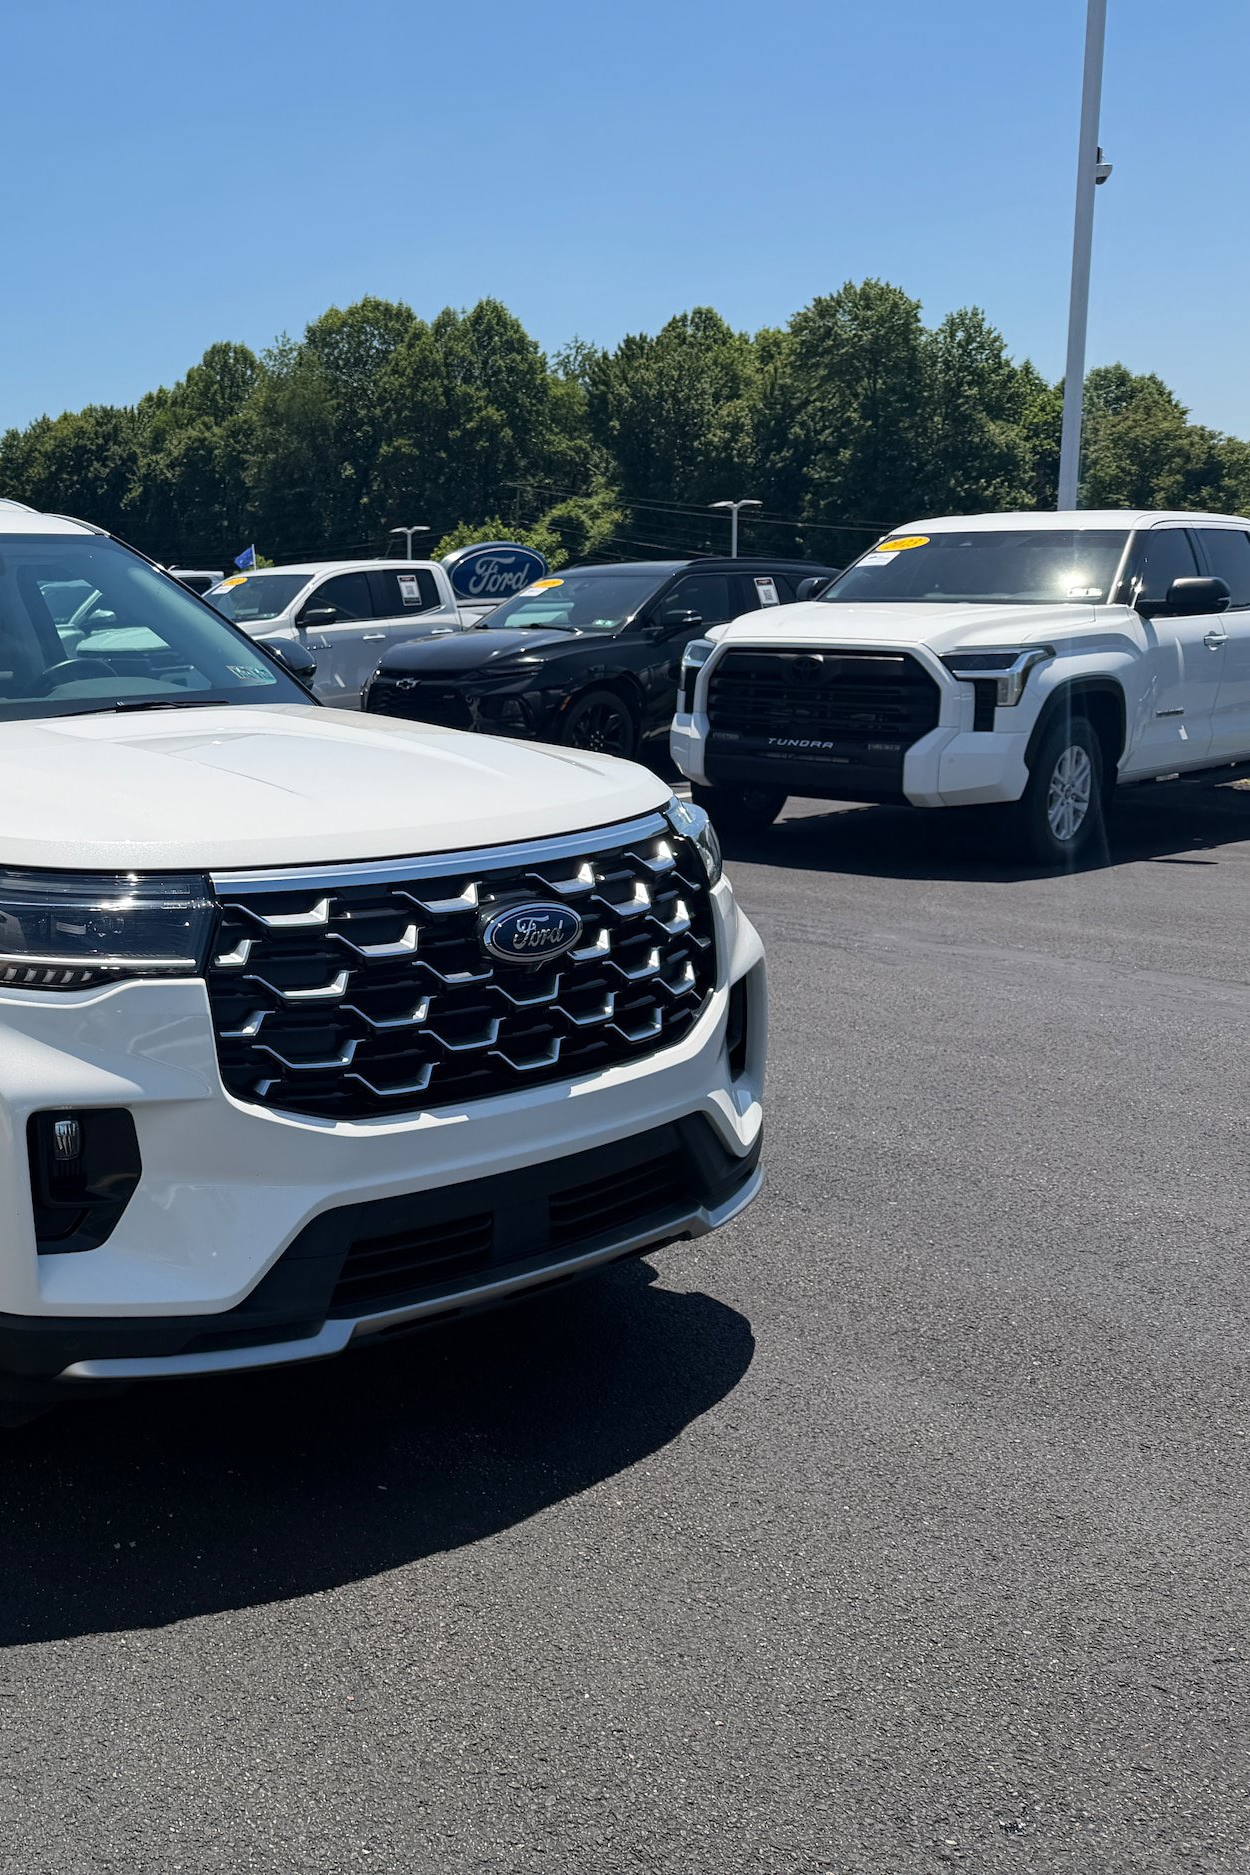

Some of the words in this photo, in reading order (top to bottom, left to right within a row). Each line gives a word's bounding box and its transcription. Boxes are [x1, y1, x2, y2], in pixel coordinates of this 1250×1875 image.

[468, 556, 530, 595] Ford
[768, 737, 834, 749] TUNDRA
[512, 915, 565, 950] Ford
